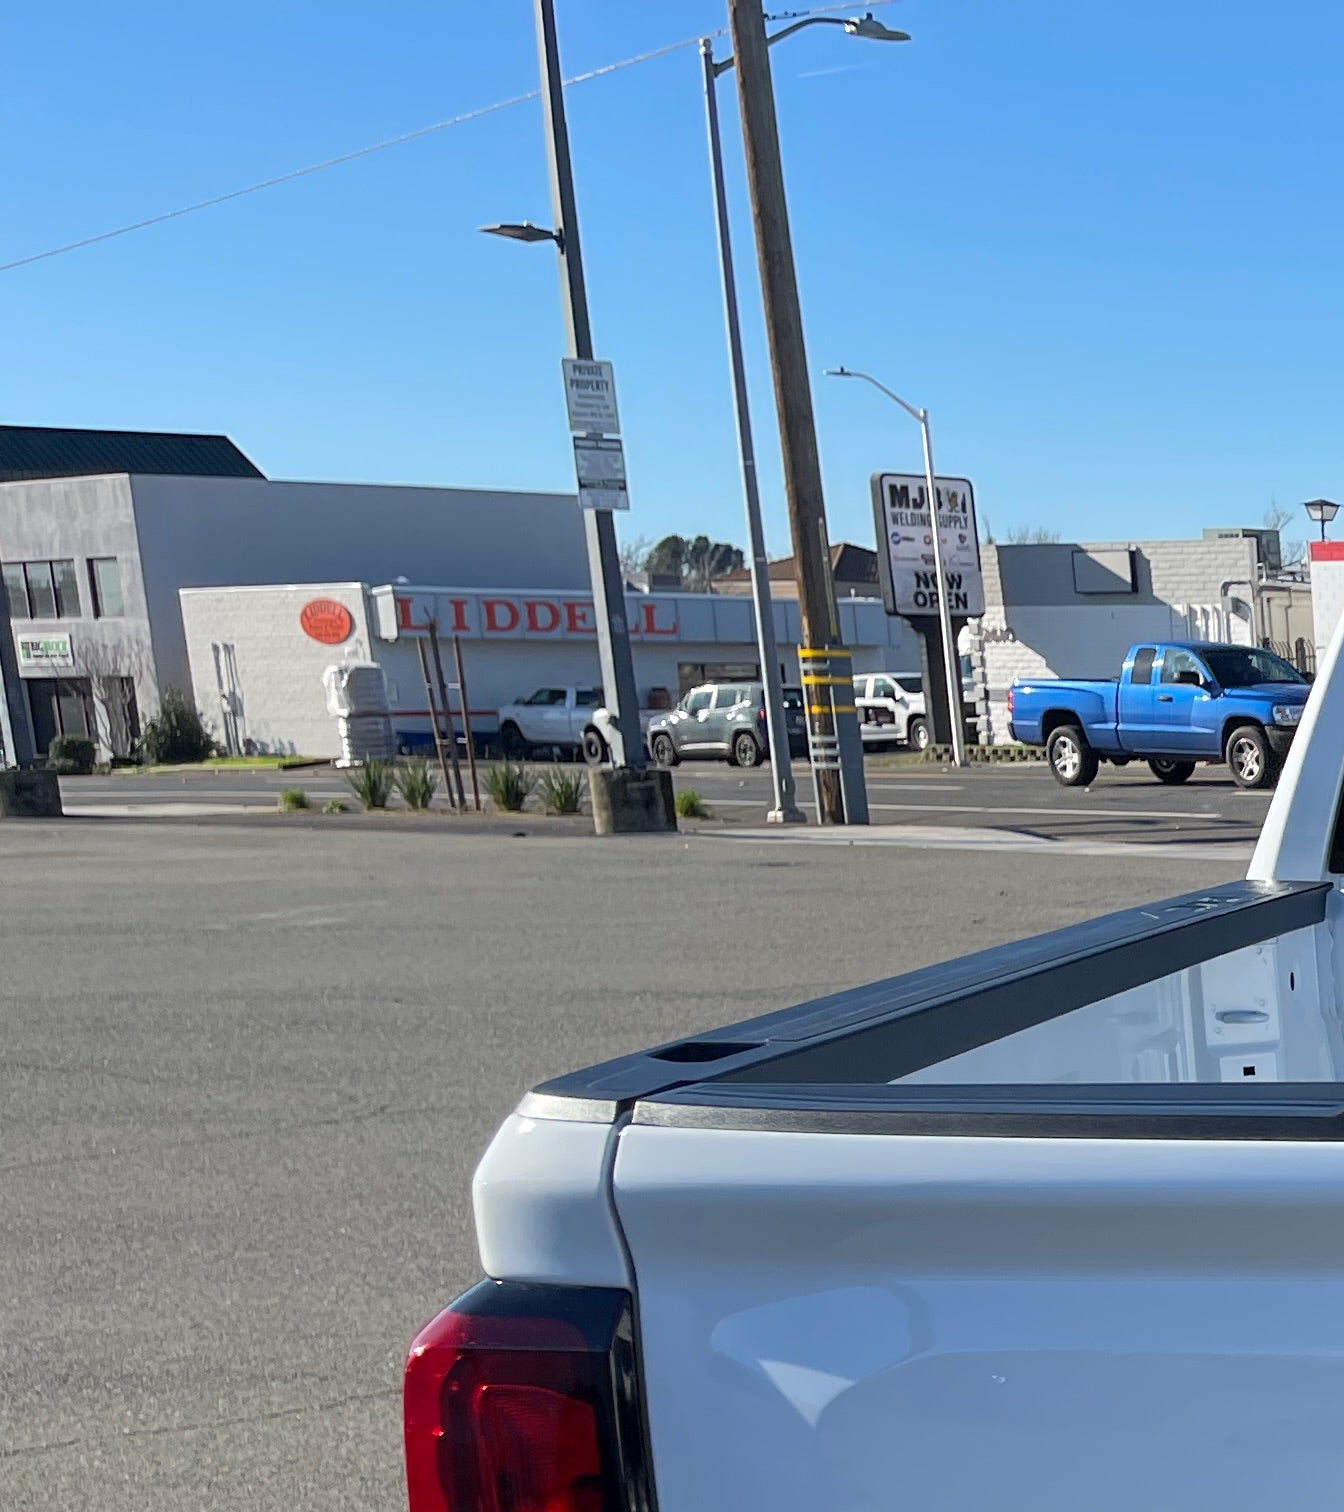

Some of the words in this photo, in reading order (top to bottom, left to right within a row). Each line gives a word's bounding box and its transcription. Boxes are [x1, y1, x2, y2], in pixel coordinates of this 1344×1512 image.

[891, 512, 933, 528] WELDING
[938, 514, 968, 529] SUPPLY
[914, 591, 968, 609] OPEN
[396, 596, 678, 635] LIDDEL
